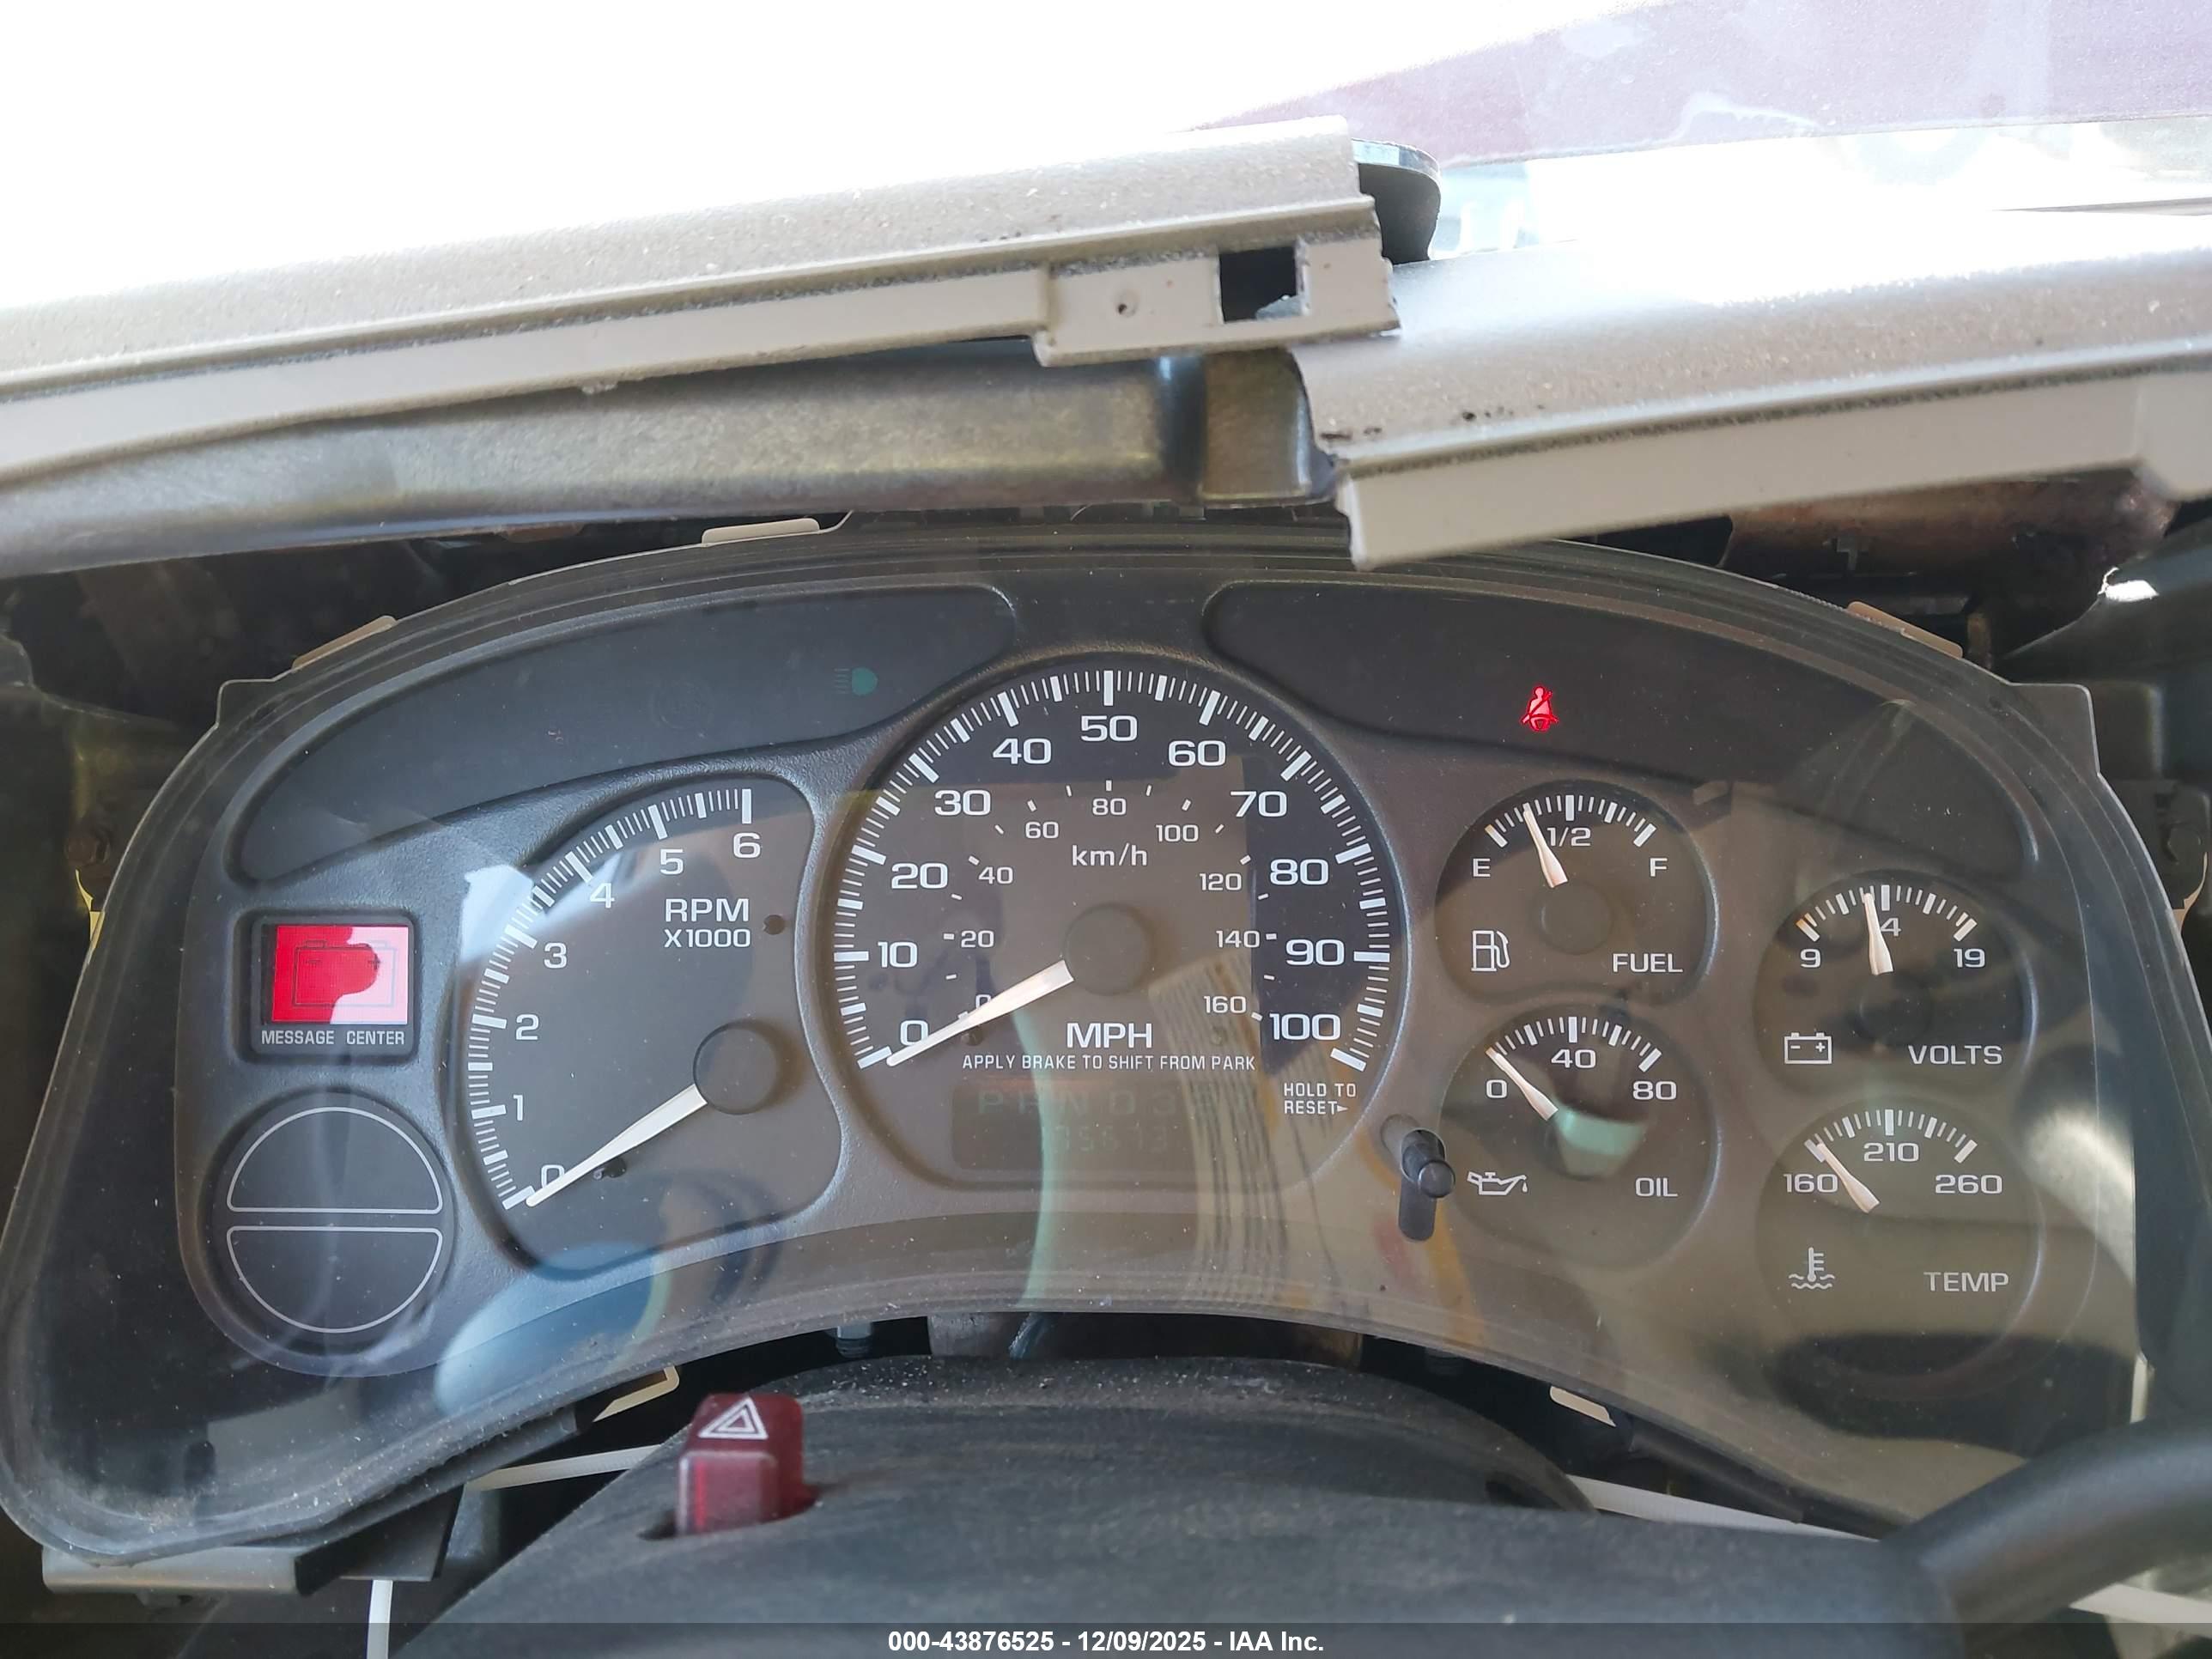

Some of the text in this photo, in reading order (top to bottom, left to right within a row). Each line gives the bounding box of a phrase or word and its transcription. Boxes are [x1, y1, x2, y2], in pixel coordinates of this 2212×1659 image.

[1081, 715, 1138, 742] 50
[993, 738, 1052, 764] 40
[1168, 740, 1226, 767] 60
[934, 789, 991, 816] 30
[1092, 798, 1127, 816] 80
[1230, 791, 1287, 817] 70
[1025, 821, 1059, 839] 60
[1155, 824, 1199, 842] 100
[1547, 827, 1591, 847] 1/2
[733, 832, 761, 859] 6
[1072, 842, 1147, 866] km/h
[659, 848, 684, 875] 5
[1473, 858, 1491, 878] E
[1650, 858, 1668, 877] F
[891, 862, 948, 889] 20
[978, 866, 1013, 884] 40
[1199, 872, 1242, 891] 120
[1270, 859, 1328, 885] 80
[589, 883, 616, 909] 4
[665, 898, 749, 922] RPM
[1879, 917, 1902, 937] 4
[664, 928, 750, 948] X1000
[961, 930, 994, 948] 20
[1216, 930, 1260, 948] 140
[544, 942, 568, 969] 3
[878, 941, 918, 968] 10
[1285, 939, 1345, 966] 90
[1800, 948, 1821, 968] 9
[1954, 948, 1985, 968] 19
[1613, 953, 1683, 973] FUEL
[1203, 995, 1247, 1013] 160
[515, 1013, 539, 1041] 2
[899, 1019, 929, 1047] 0
[1066, 1023, 1152, 1048] MPH
[1269, 1013, 1341, 1041] 100
[261, 1030, 404, 1045] MESSAGE CENTER
[962, 1054, 1255, 1071] APPLY BRAKE TO SHIFT FROM PARK
[1551, 1048, 1596, 1068] 40
[1908, 1045, 2002, 1065] VOLTS
[1284, 1082, 1356, 1097] HOLD TO
[1486, 1079, 1508, 1098] 0
[1632, 1080, 1677, 1100] 80
[513, 1094, 524, 1121] 1
[1283, 1100, 1337, 1115] RESET
[1863, 1142, 1919, 1162] 210
[1635, 1177, 1678, 1197] OIL
[1784, 1174, 1838, 1194] 160
[1935, 1174, 2002, 1194] 260
[1923, 1272, 2009, 1292] TEMP
